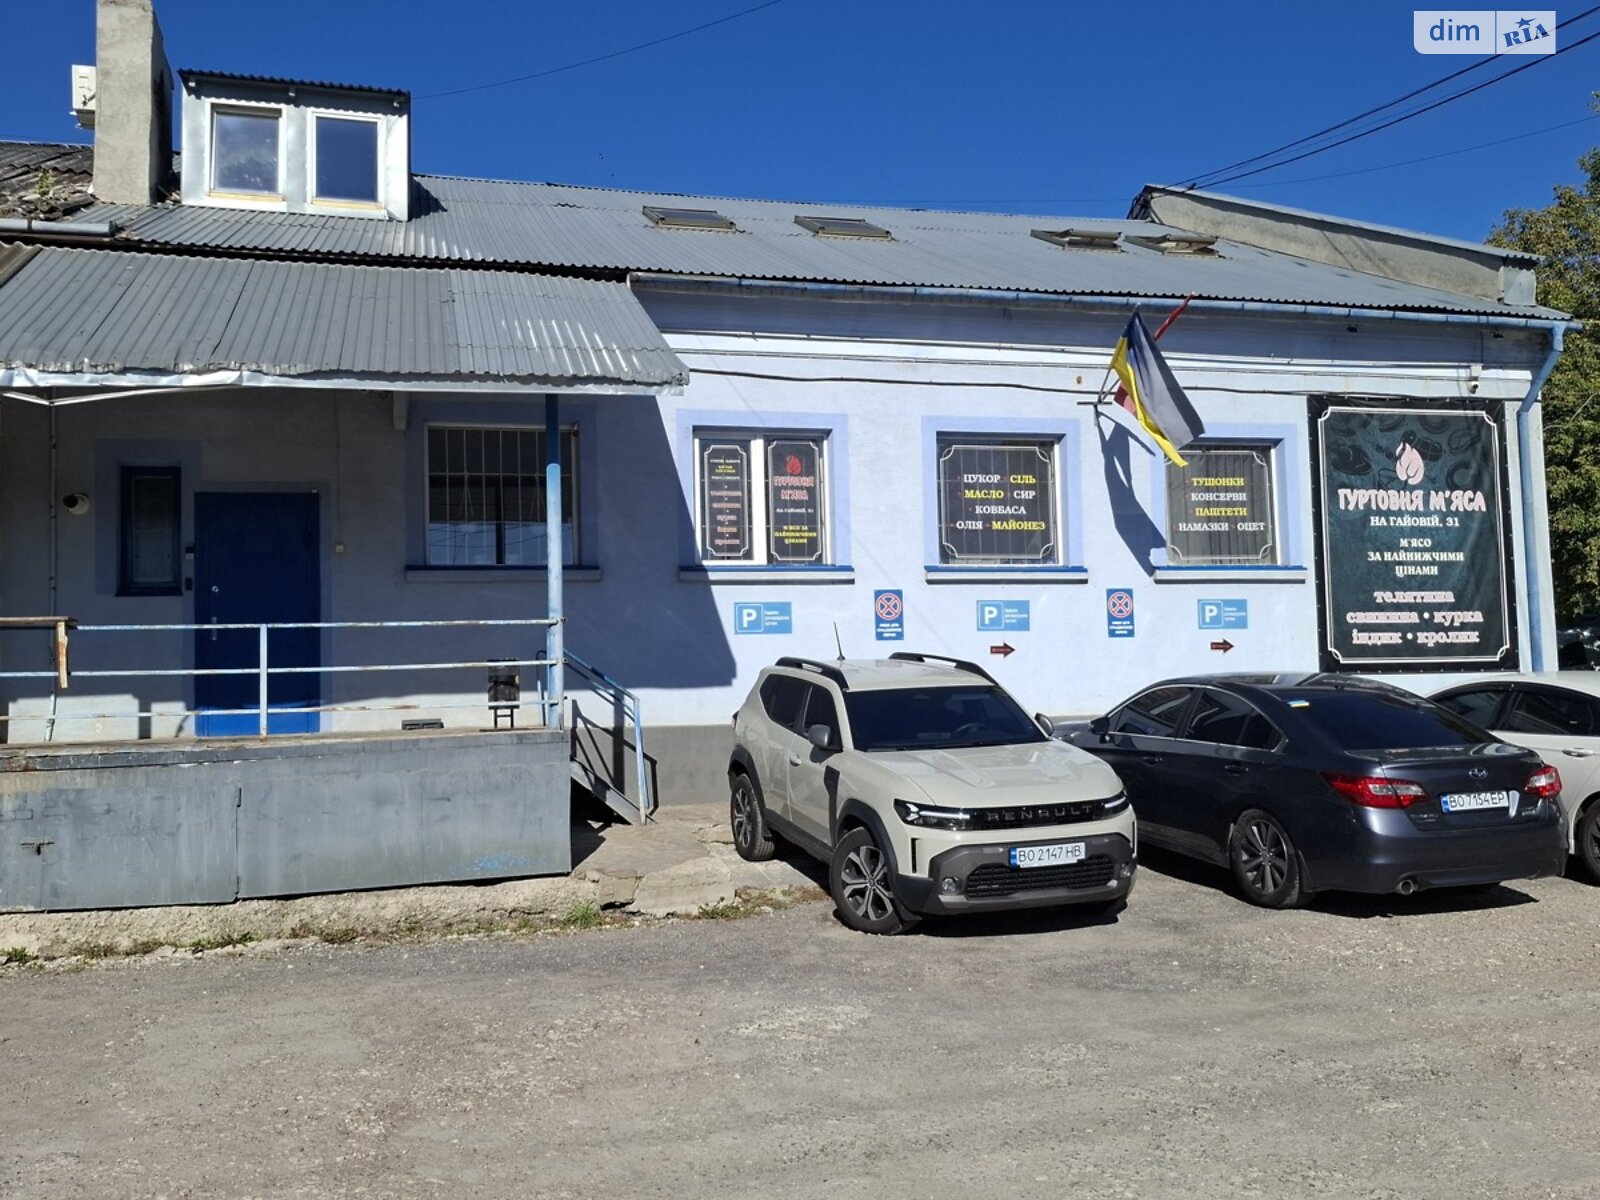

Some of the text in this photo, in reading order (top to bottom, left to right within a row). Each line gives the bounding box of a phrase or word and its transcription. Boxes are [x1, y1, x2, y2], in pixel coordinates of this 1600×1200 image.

[963, 474, 1036, 484] ЦУКОР СІЛЬ
[1191, 477, 1245, 486] ТУШОНКИ
[964, 489, 1036, 499] МАСЛО СИР
[1191, 493, 1247, 501] КОНСЕРВИ
[1337, 488, 1487, 512] ГУРТОВНЯ М'ЯСА
[975, 505, 1027, 514] КОВБАСА
[1195, 507, 1248, 516] ПАШТЕТИ
[956, 519, 1045, 530] ОЛІЯ МАЙОНЕЗ
[1179, 522, 1266, 531] НАМАЗКИ ОЦЕТ
[1370, 516, 1387, 526] НА
[1446, 516, 1460, 527] 31
[1400, 538, 1432, 548] М'ЯСО
[1367, 551, 1464, 561] ЗА НАЙНИЖЧИМИ
[1395, 565, 1438, 577] ЦІНАМИ
[742, 608, 757, 628] P
[984, 606, 998, 625] P
[1204, 605, 1218, 623] P
[1433, 610, 1484, 627] курка
[987, 804, 1093, 821] RENAULT
[1018, 844, 1082, 863] BO 2147 HB
